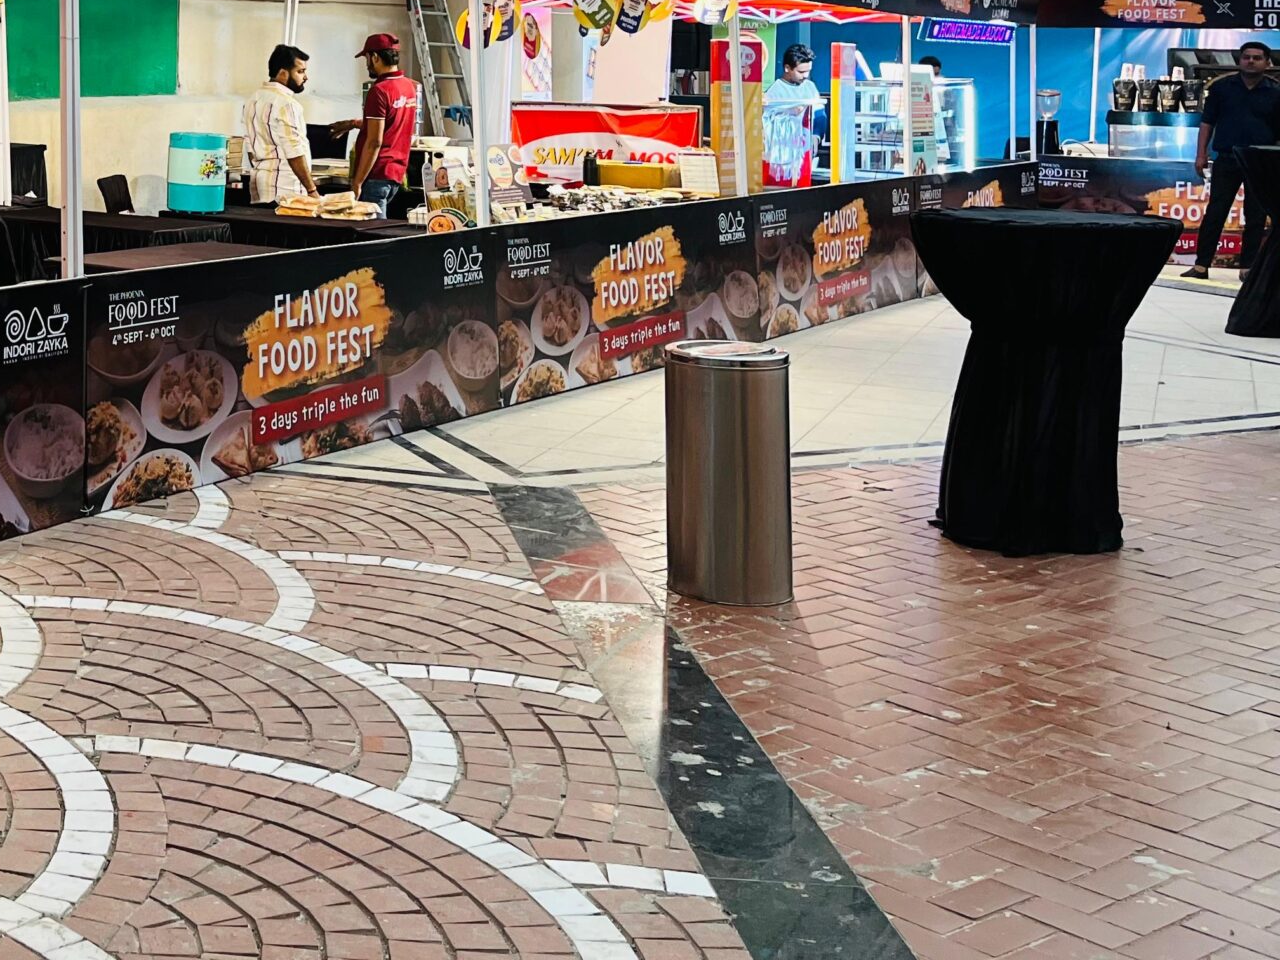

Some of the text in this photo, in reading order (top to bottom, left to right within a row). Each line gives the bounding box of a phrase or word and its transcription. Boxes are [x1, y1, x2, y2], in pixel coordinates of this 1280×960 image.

[1118, 8, 1186, 19] FOOD FEST
[939, 22, 982, 39] HOMEMADE
[1038, 168, 1089, 178] OOD FEST
[823, 207, 858, 234] FLAVOR
[1158, 202, 1207, 222] FOO
[507, 243, 551, 262] FOOD FEST
[609, 236, 665, 271] FLAVOR
[818, 235, 864, 265] FOOD FEST
[1176, 239, 1195, 249] ays
[464, 270, 483, 283] ZAYKA
[518, 269, 530, 278] SEPT
[540, 265, 549, 274] OCT
[109, 293, 120, 301] THE
[601, 271, 675, 309] FOOD FEST
[109, 295, 179, 323] FOOD FEST
[274, 282, 358, 328] FLAVOR
[112, 334, 122, 346] 4th
[123, 330, 144, 344] SEPT
[150, 327, 160, 340] 6th
[161, 325, 176, 337] OCT
[604, 319, 681, 353] 3 days triple the fun
[3, 342, 35, 360] INDORI
[37, 336, 69, 353] ZAYKA
[258, 324, 374, 380] FOOD FEST
[259, 385, 380, 436] 3 days triple the fun
